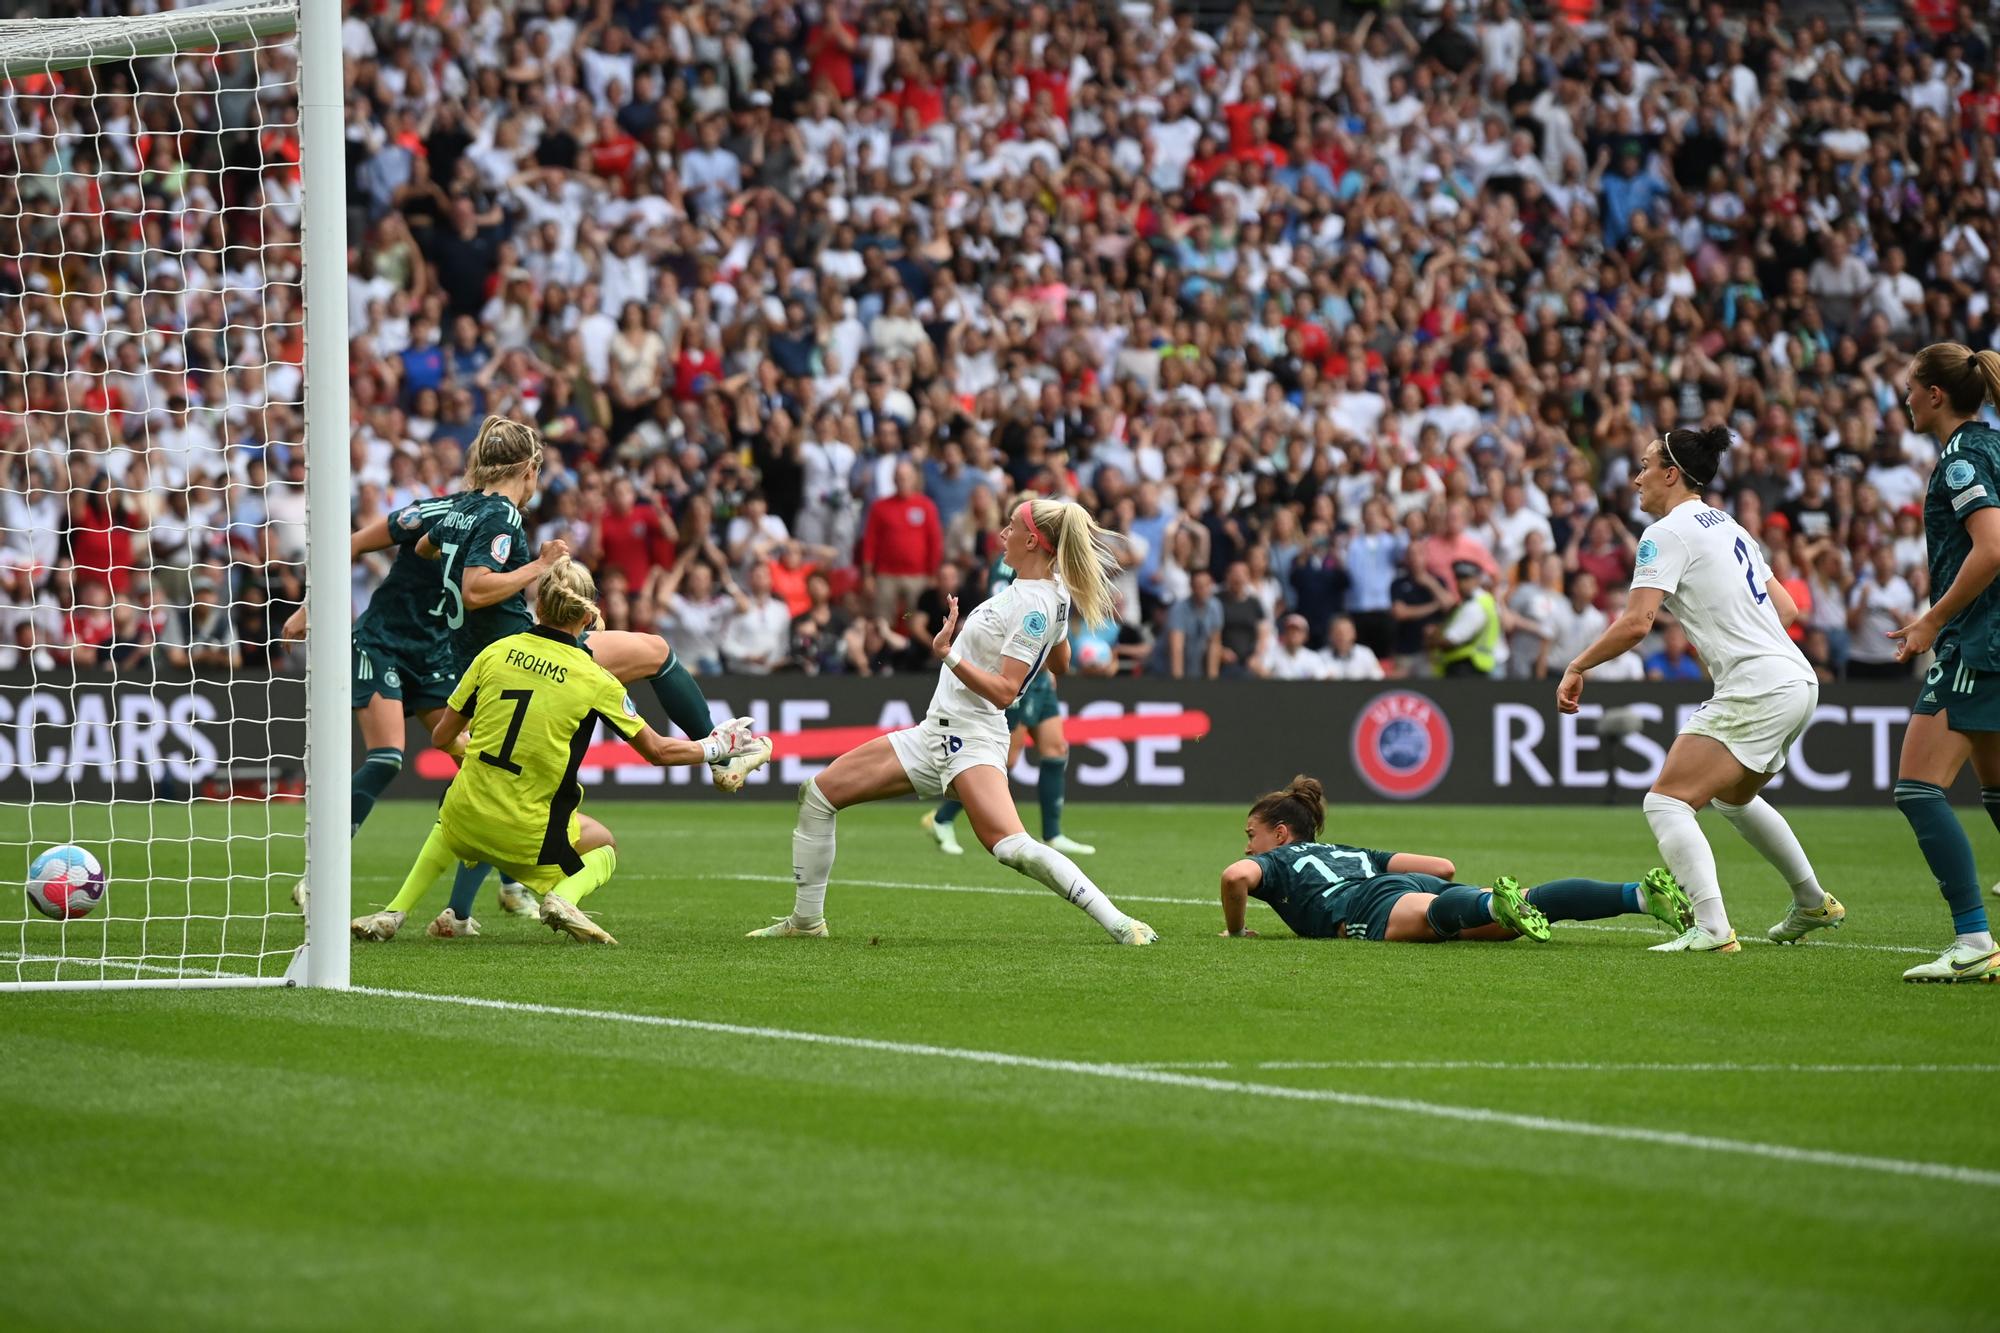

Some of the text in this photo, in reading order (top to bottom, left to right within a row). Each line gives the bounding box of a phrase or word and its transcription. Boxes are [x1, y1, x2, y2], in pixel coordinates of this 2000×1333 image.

[1733, 536, 1767, 605] 2
[505, 649, 568, 683] FROHMS
[478, 689, 534, 776] 1
[1493, 703, 1910, 791] RESCT
